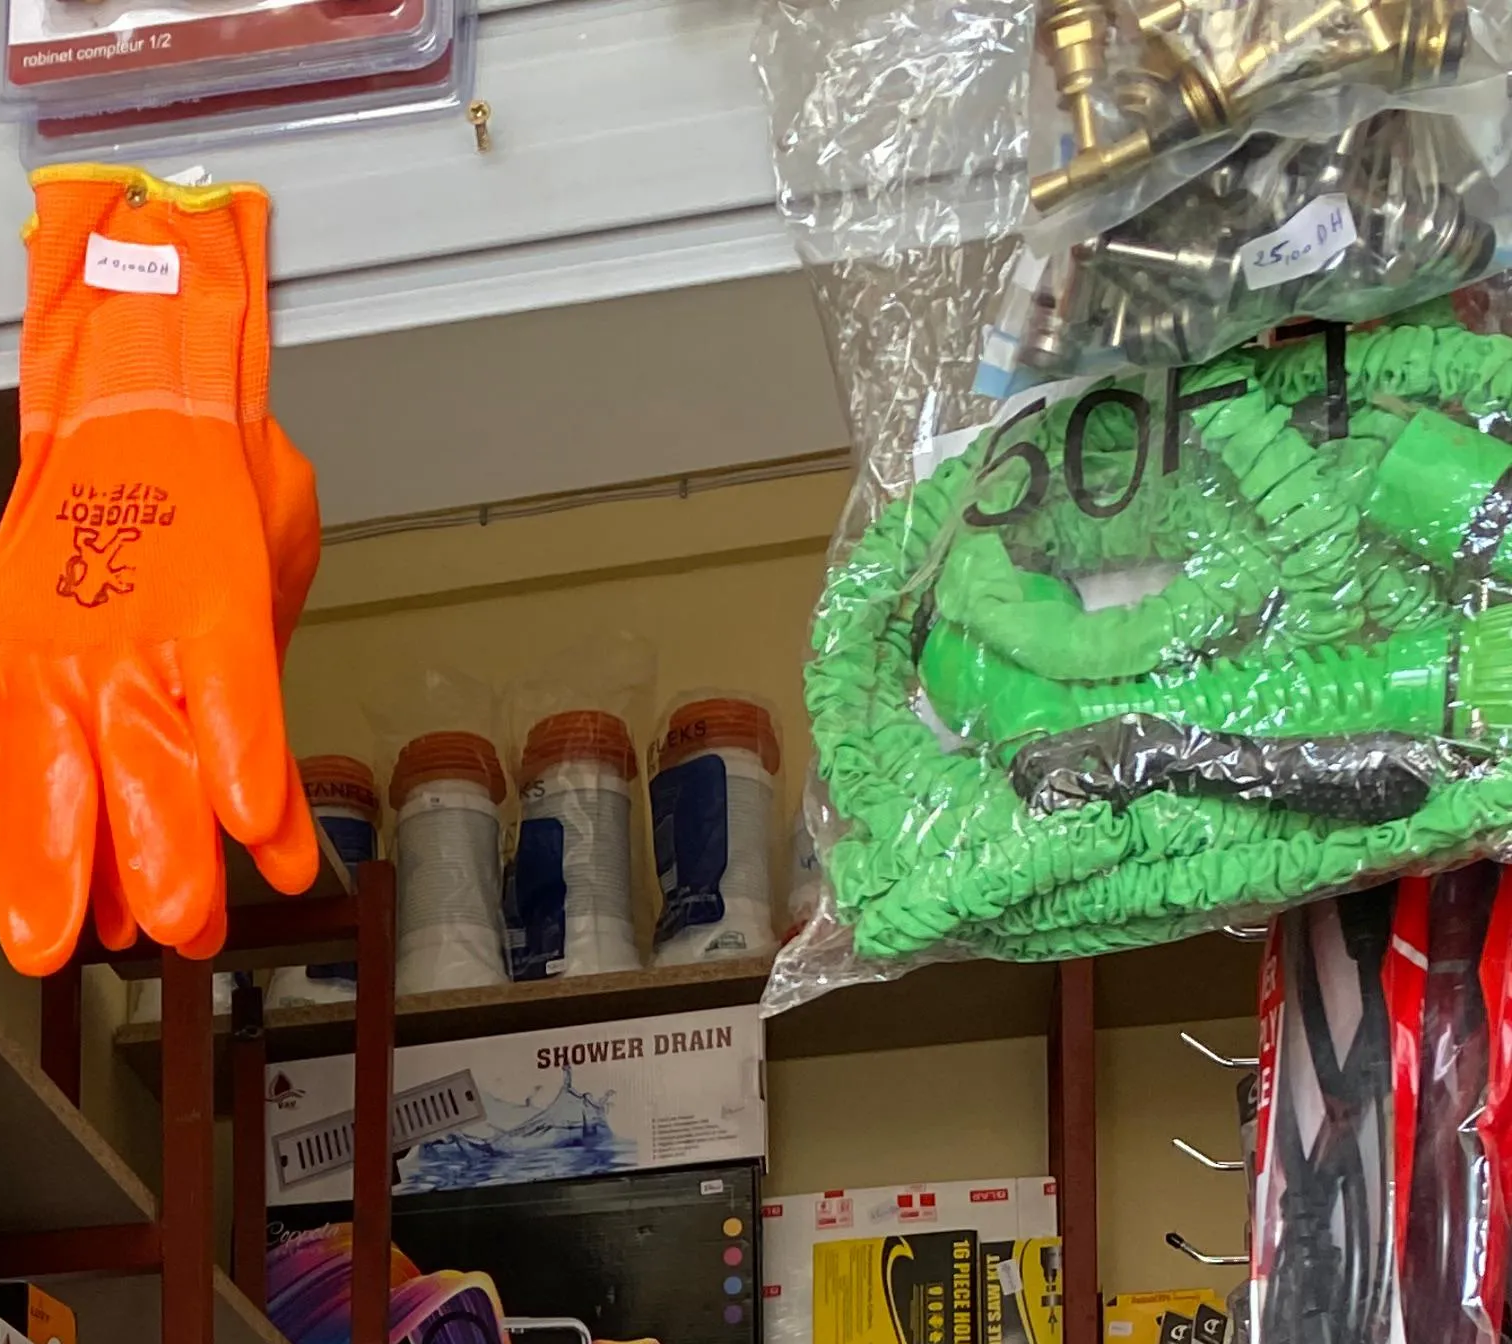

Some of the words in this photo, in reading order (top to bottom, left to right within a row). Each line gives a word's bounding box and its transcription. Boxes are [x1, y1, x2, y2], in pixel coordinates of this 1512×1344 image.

[23, 49, 72, 68] robinet
[75, 38, 146, 62] compteur
[149, 33, 172, 49] 1/2
[1315, 209, 1348, 251] DH
[56, 500, 176, 527] PEUGEOT
[537, 1037, 644, 1069] SHOWER
[654, 1026, 733, 1055] DRAIN
[953, 1240, 971, 1259] 16
[953, 1263, 971, 1308] PIECE
[987, 1284, 1001, 1321] SAW
